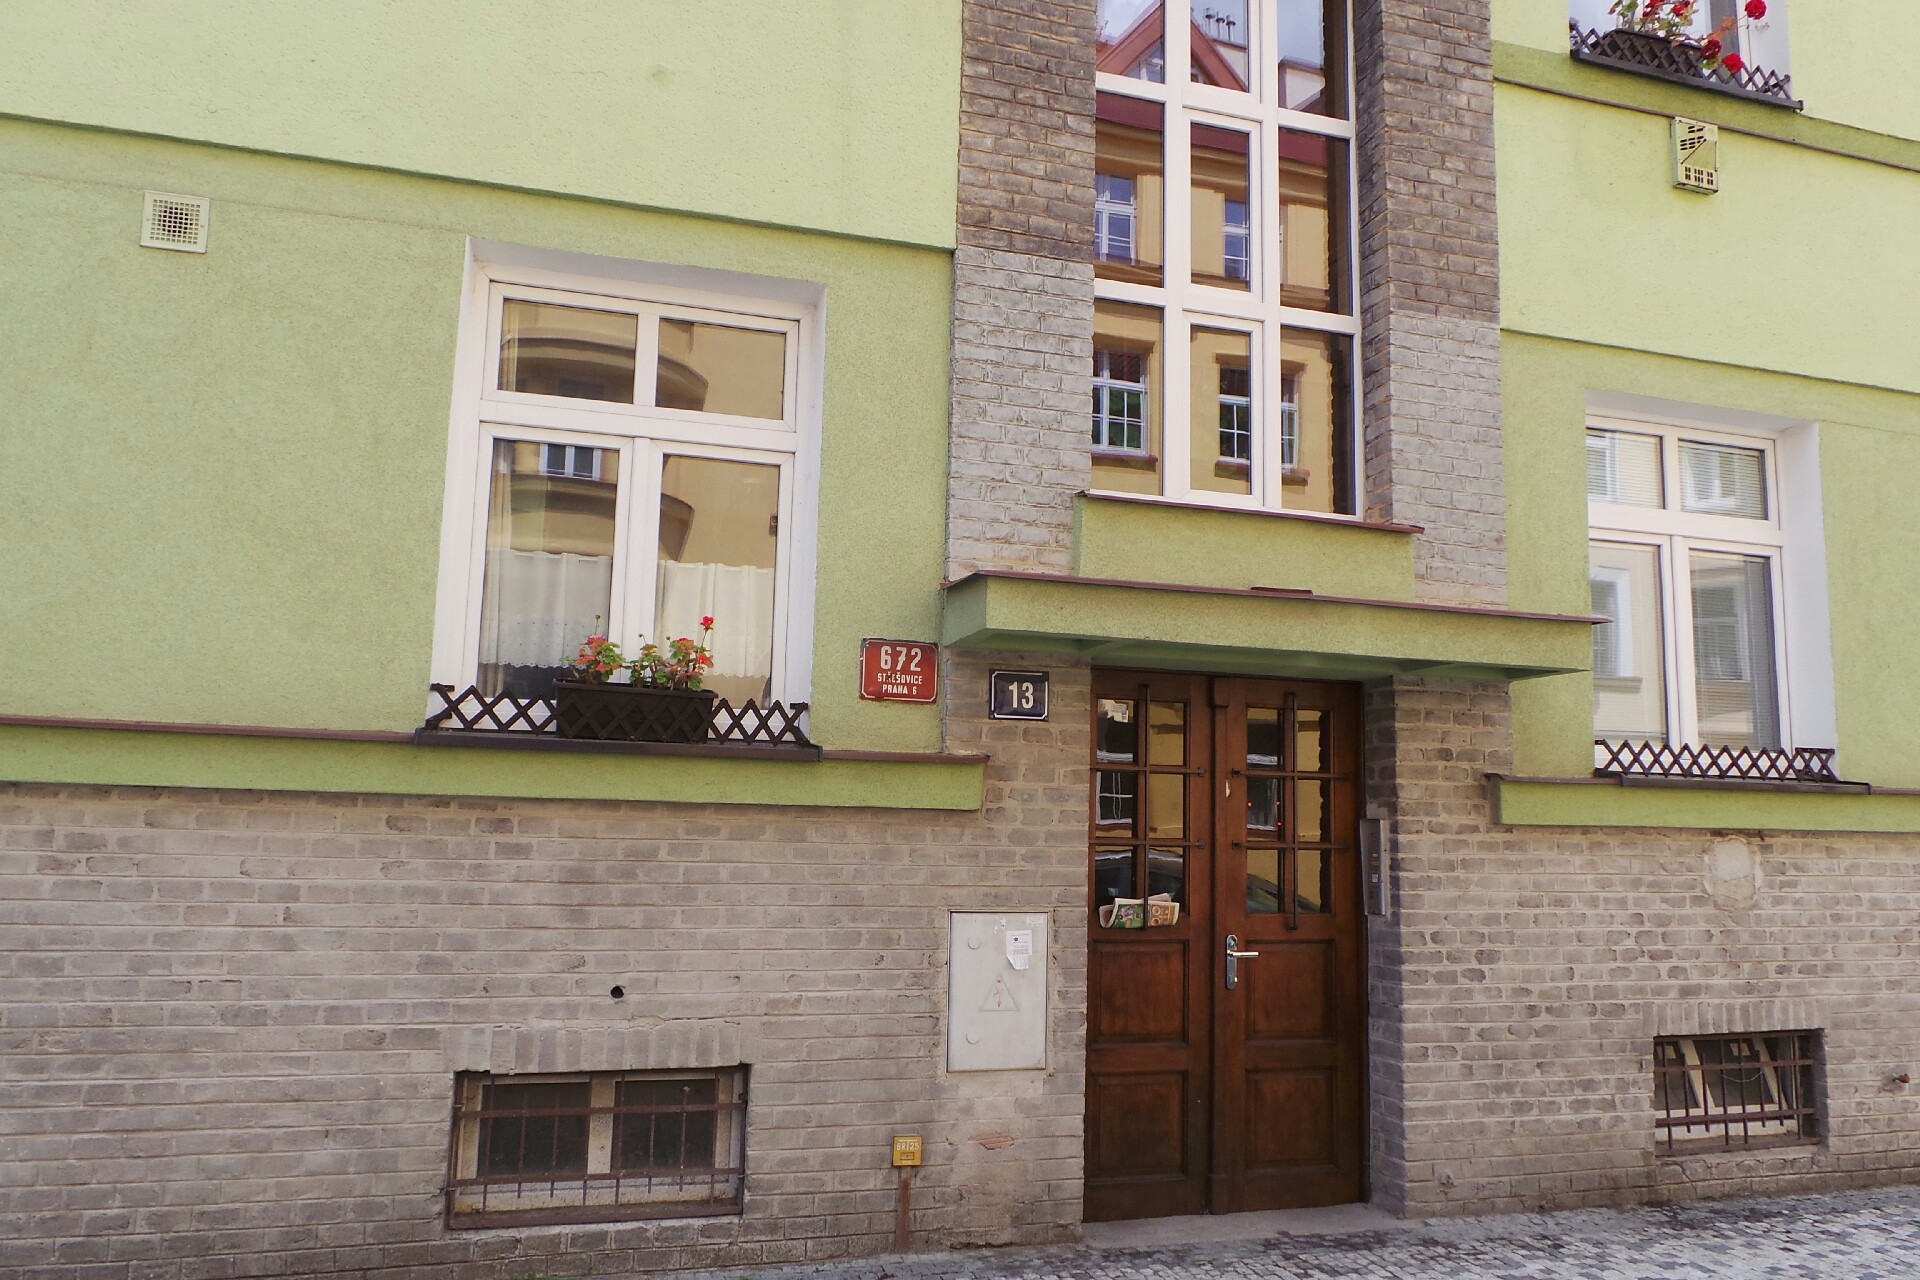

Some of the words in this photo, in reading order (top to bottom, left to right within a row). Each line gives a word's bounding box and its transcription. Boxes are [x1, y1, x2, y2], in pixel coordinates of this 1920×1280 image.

[880, 645, 922, 672] 672
[882, 684, 908, 695] PRAHA
[913, 686, 918, 695] 6
[1008, 681, 1034, 709] 13
